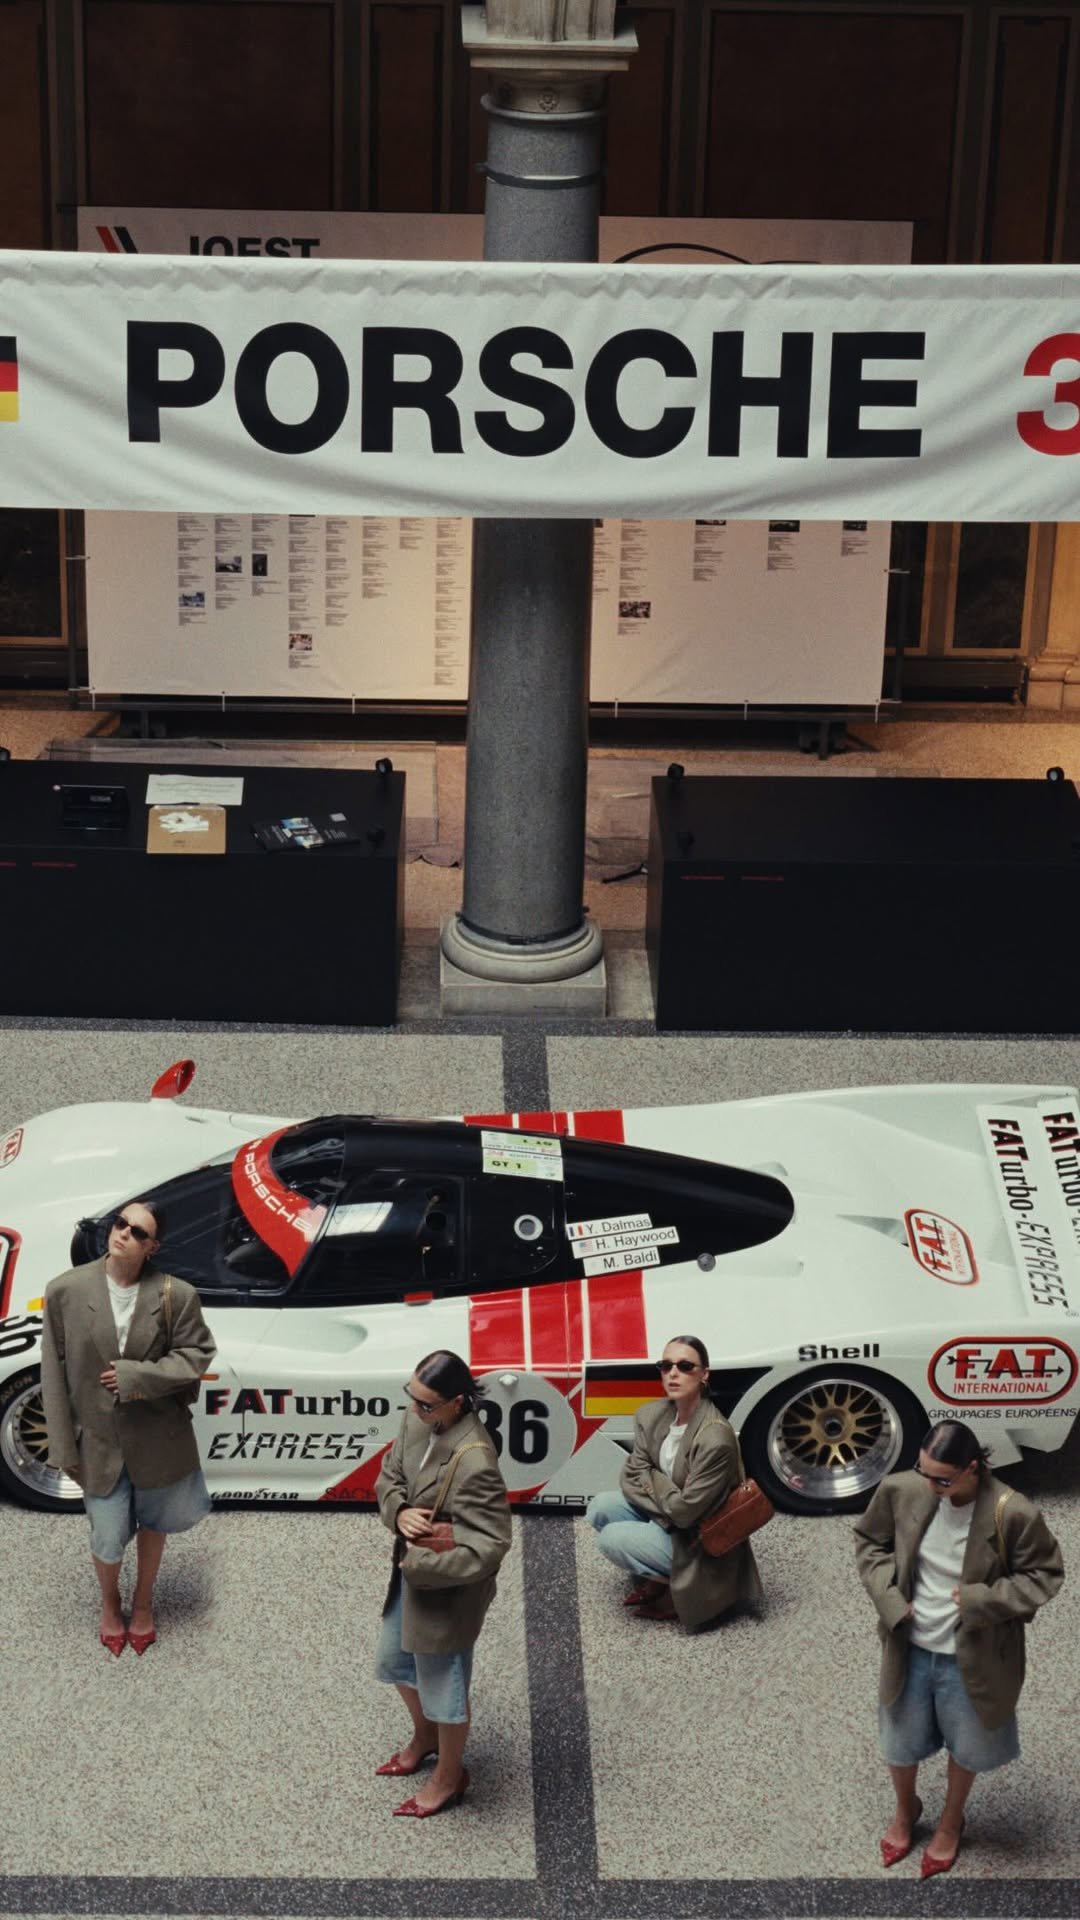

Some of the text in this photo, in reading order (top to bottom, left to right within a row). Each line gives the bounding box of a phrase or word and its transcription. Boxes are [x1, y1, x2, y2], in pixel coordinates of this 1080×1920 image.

[126, 320, 926, 460] PORSCHE
[245, 1152, 313, 1231] PORSCHE
[586, 1217, 651, 1235] Y. Dalmas
[595, 1228, 676, 1250] H. Haywood
[603, 1250, 658, 1270] M. Baldi
[798, 1343, 880, 1362] Shell
[953, 1381, 1051, 1394] INTERNATIONAL
[928, 1407, 1001, 1419] GROUPAGES
